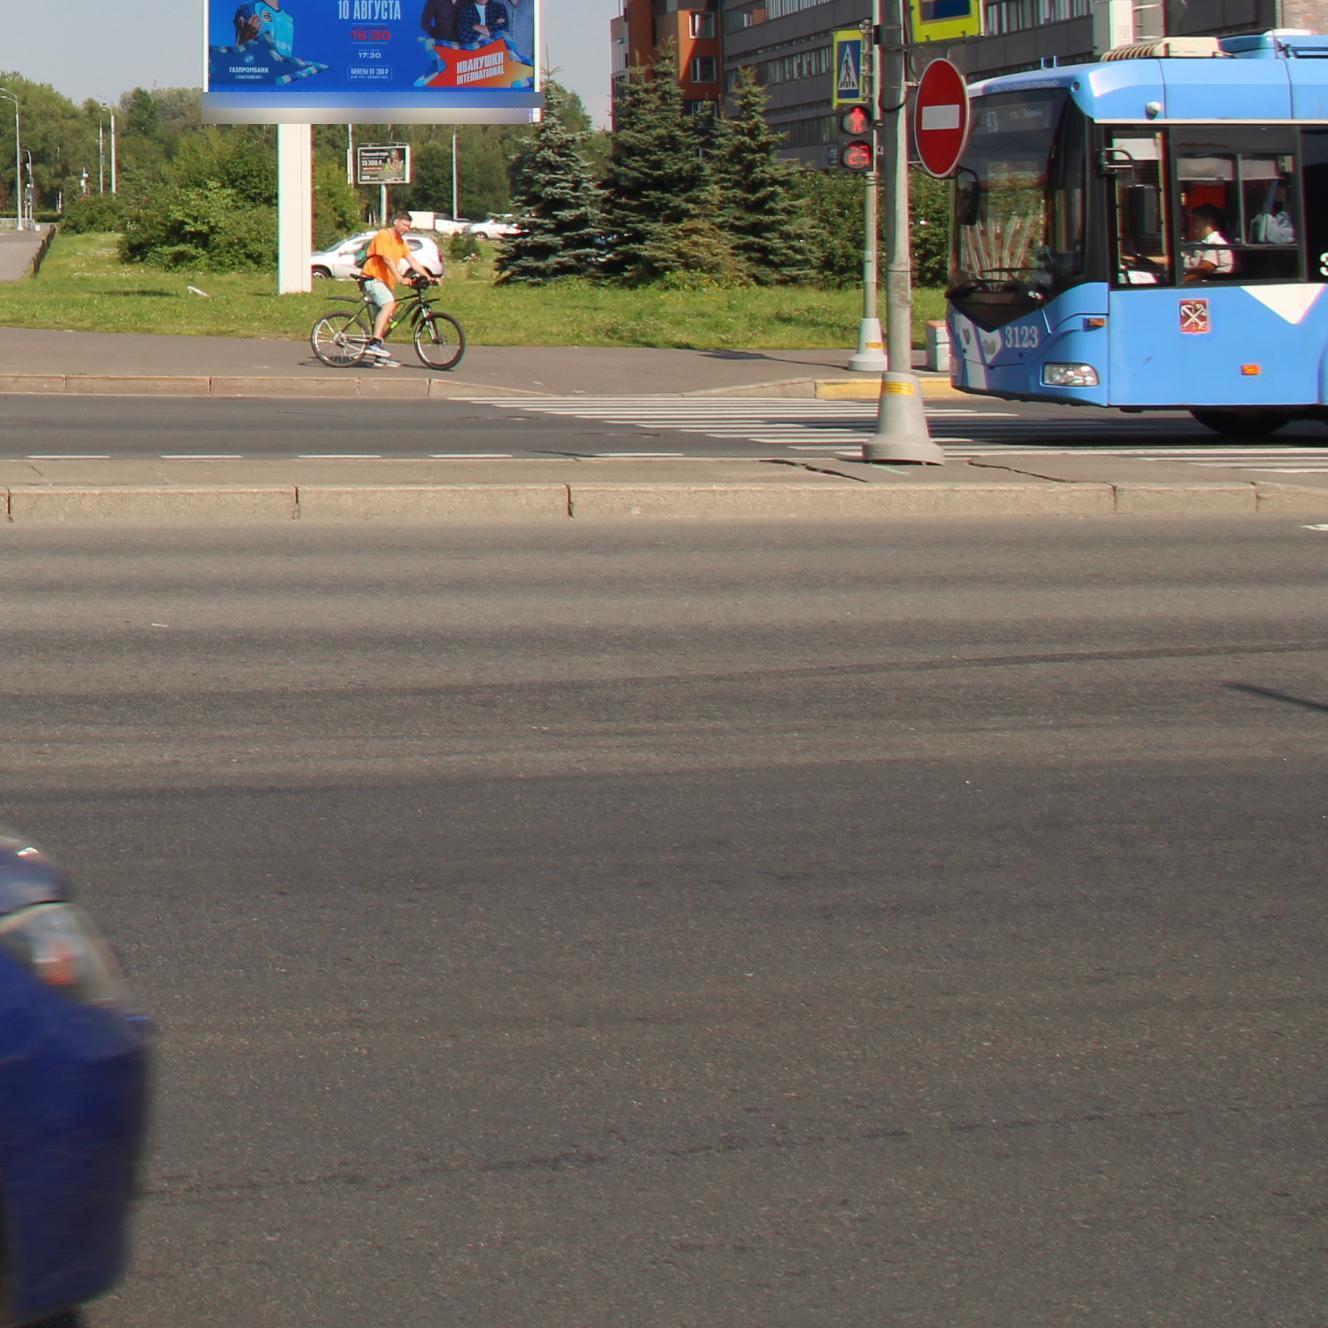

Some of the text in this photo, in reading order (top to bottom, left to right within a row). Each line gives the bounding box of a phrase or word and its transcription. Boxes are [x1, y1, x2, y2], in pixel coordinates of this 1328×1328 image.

[338, 0, 402, 20] 10 АВГУСТА
[456, 51, 504, 75] ИВАНУШКИ
[456, 65, 505, 86] INTERNATIONAL
[1004, 325, 1039, 349] 3123
